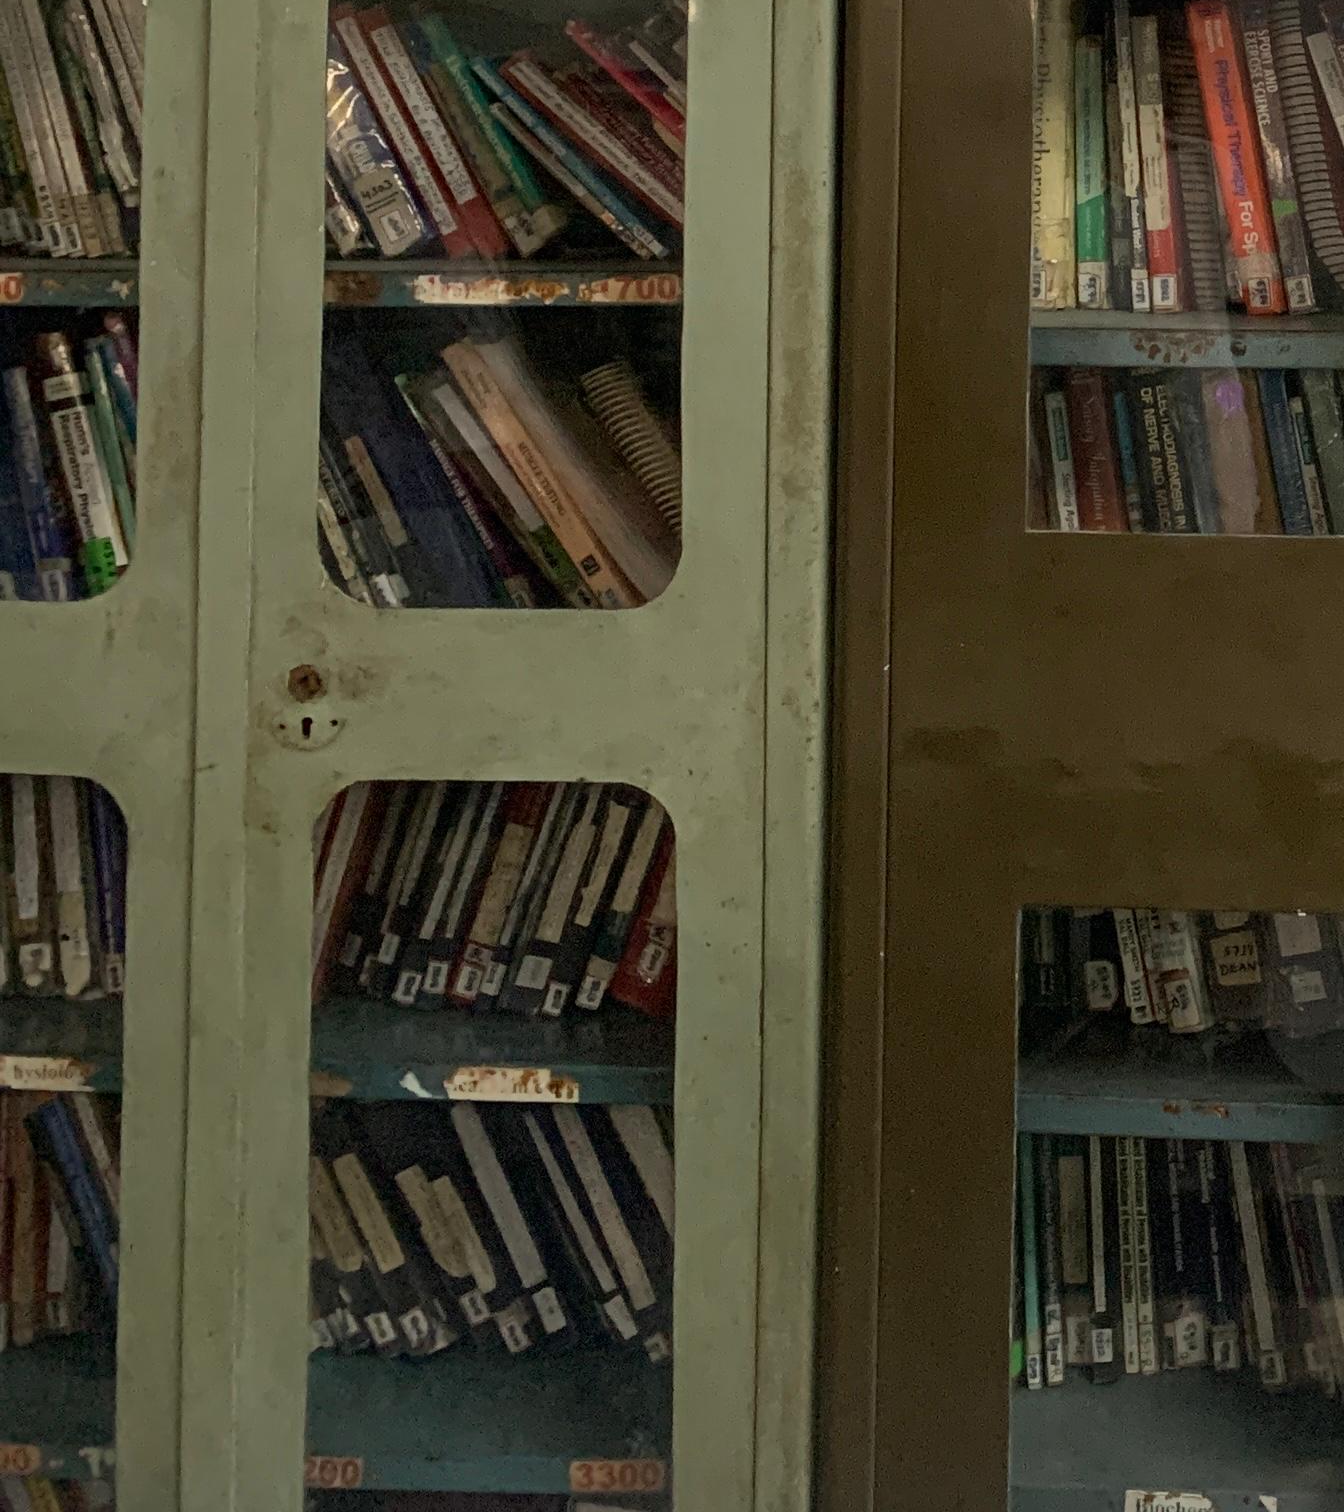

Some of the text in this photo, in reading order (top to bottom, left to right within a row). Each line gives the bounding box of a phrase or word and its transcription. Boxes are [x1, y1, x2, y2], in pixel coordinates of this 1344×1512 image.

[1242, 30, 1271, 126] EXERCISE SCIENCE
[1256, 28, 1279, 94] SPORT AND
[1223, 130, 1250, 196] Therapy
[1236, 199, 1256, 229] For
[1238, 230, 1261, 257] Sp
[57, 413, 84, 490] Respiratory
[1138, 386, 1173, 534] OF NERVE AND MUSC
[1173, 514, 1190, 530] IN
[576, 1462, 660, 1487] 3300
